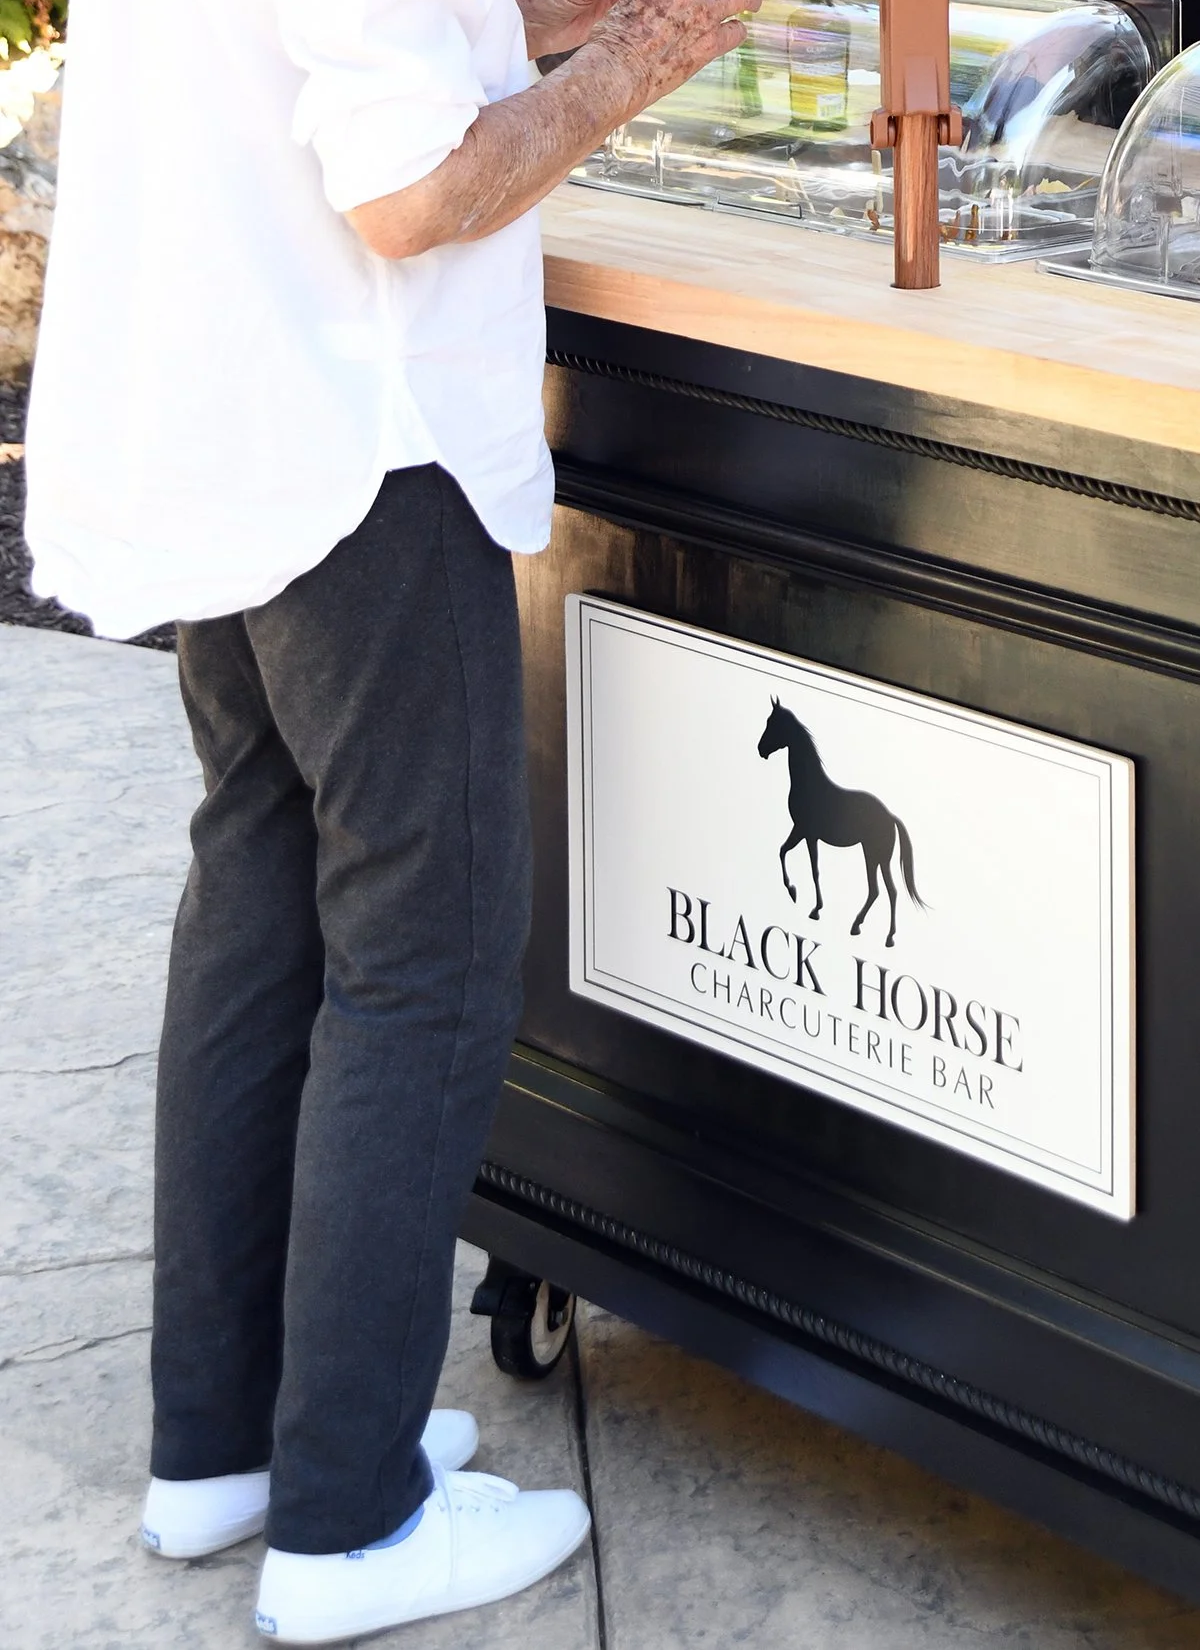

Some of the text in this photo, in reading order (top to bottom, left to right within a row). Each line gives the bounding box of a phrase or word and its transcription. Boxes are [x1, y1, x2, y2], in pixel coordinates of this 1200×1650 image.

[666, 886, 1023, 1073] BLACK HORSE
[691, 962, 994, 1109] CHARCUTERIE BAR
